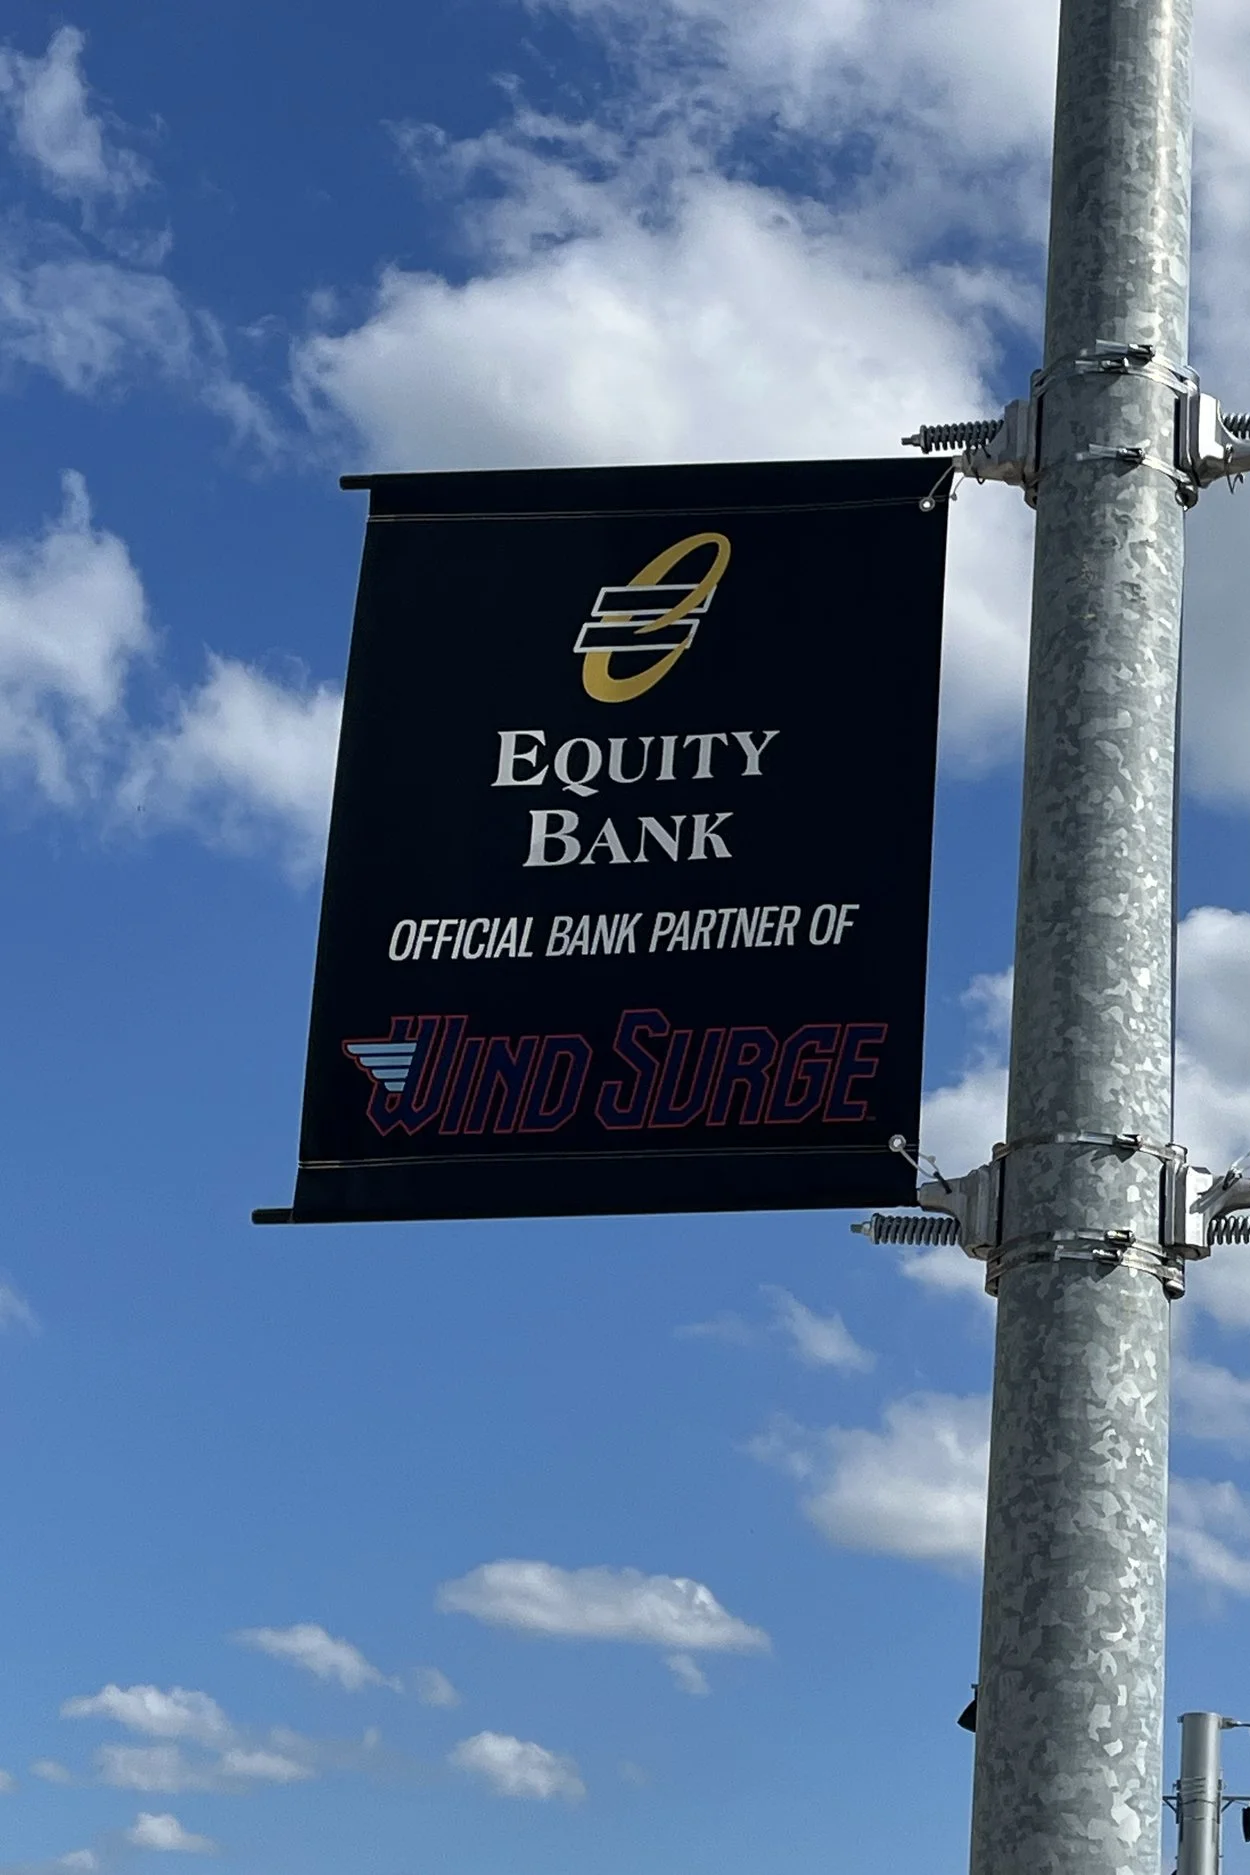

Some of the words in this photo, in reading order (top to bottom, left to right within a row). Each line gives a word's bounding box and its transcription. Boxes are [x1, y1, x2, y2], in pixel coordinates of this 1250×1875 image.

[490, 729, 781, 798] EQUITY
[521, 808, 735, 868] BANK
[388, 916, 534, 961] OFFICIAL
[545, 912, 643, 957] BANK
[648, 904, 801, 953] PARTNER
[808, 902, 861, 946] OF
[341, 1014, 594, 1137] WIND
[594, 1007, 889, 1131] SURGE
